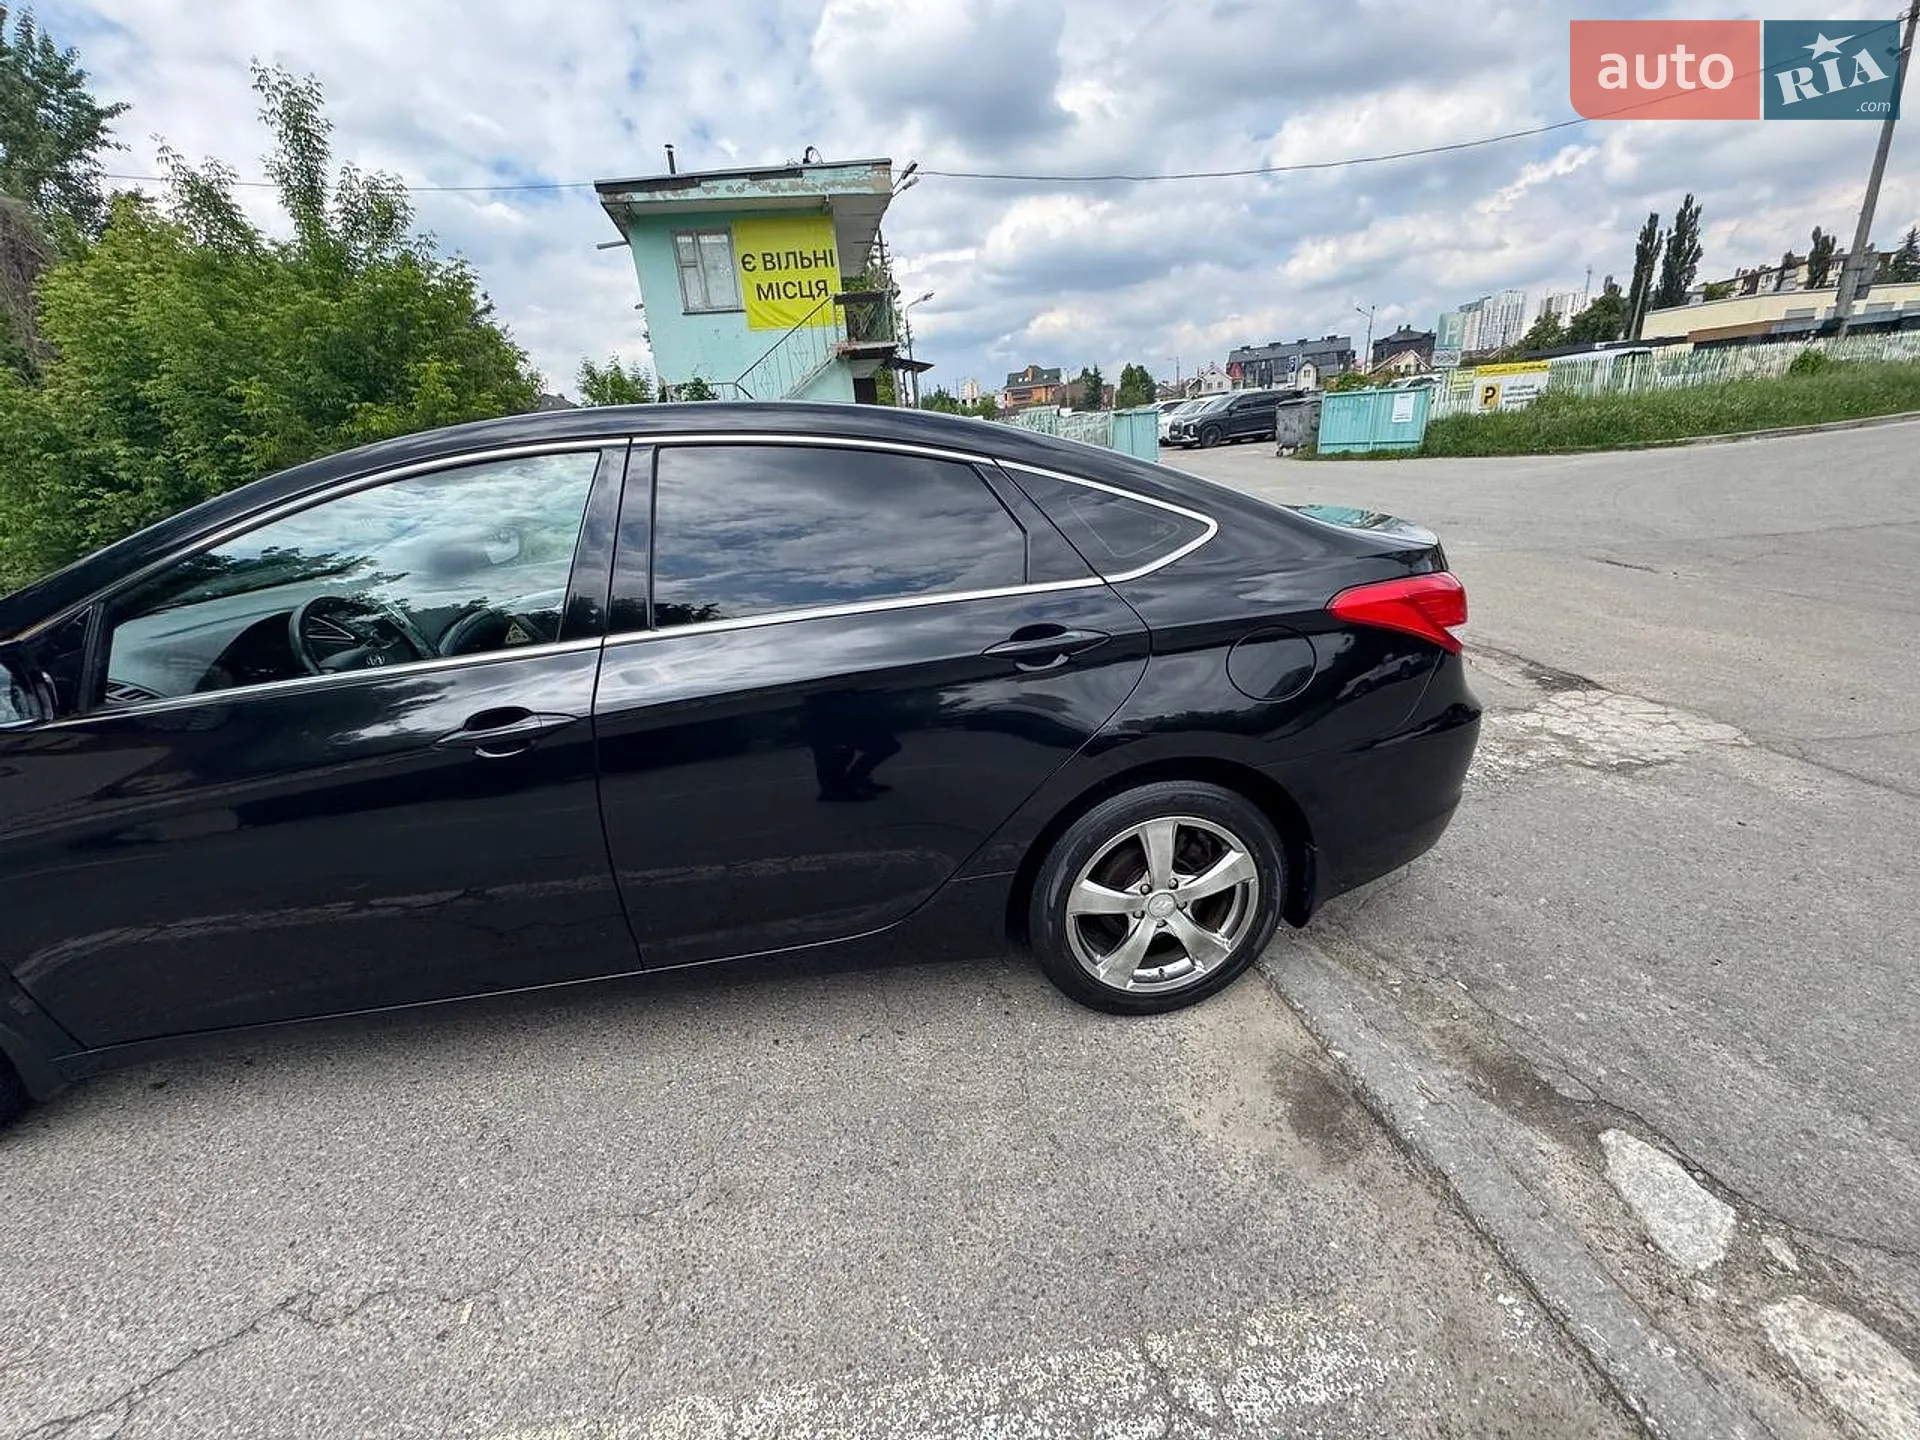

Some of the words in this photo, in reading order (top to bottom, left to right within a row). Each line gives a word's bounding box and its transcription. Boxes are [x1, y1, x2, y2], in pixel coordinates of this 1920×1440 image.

[741, 253, 757, 272] Є
[762, 249, 834, 271] ВІЛЬНІ
[756, 279, 829, 301] МІСЦЯ
